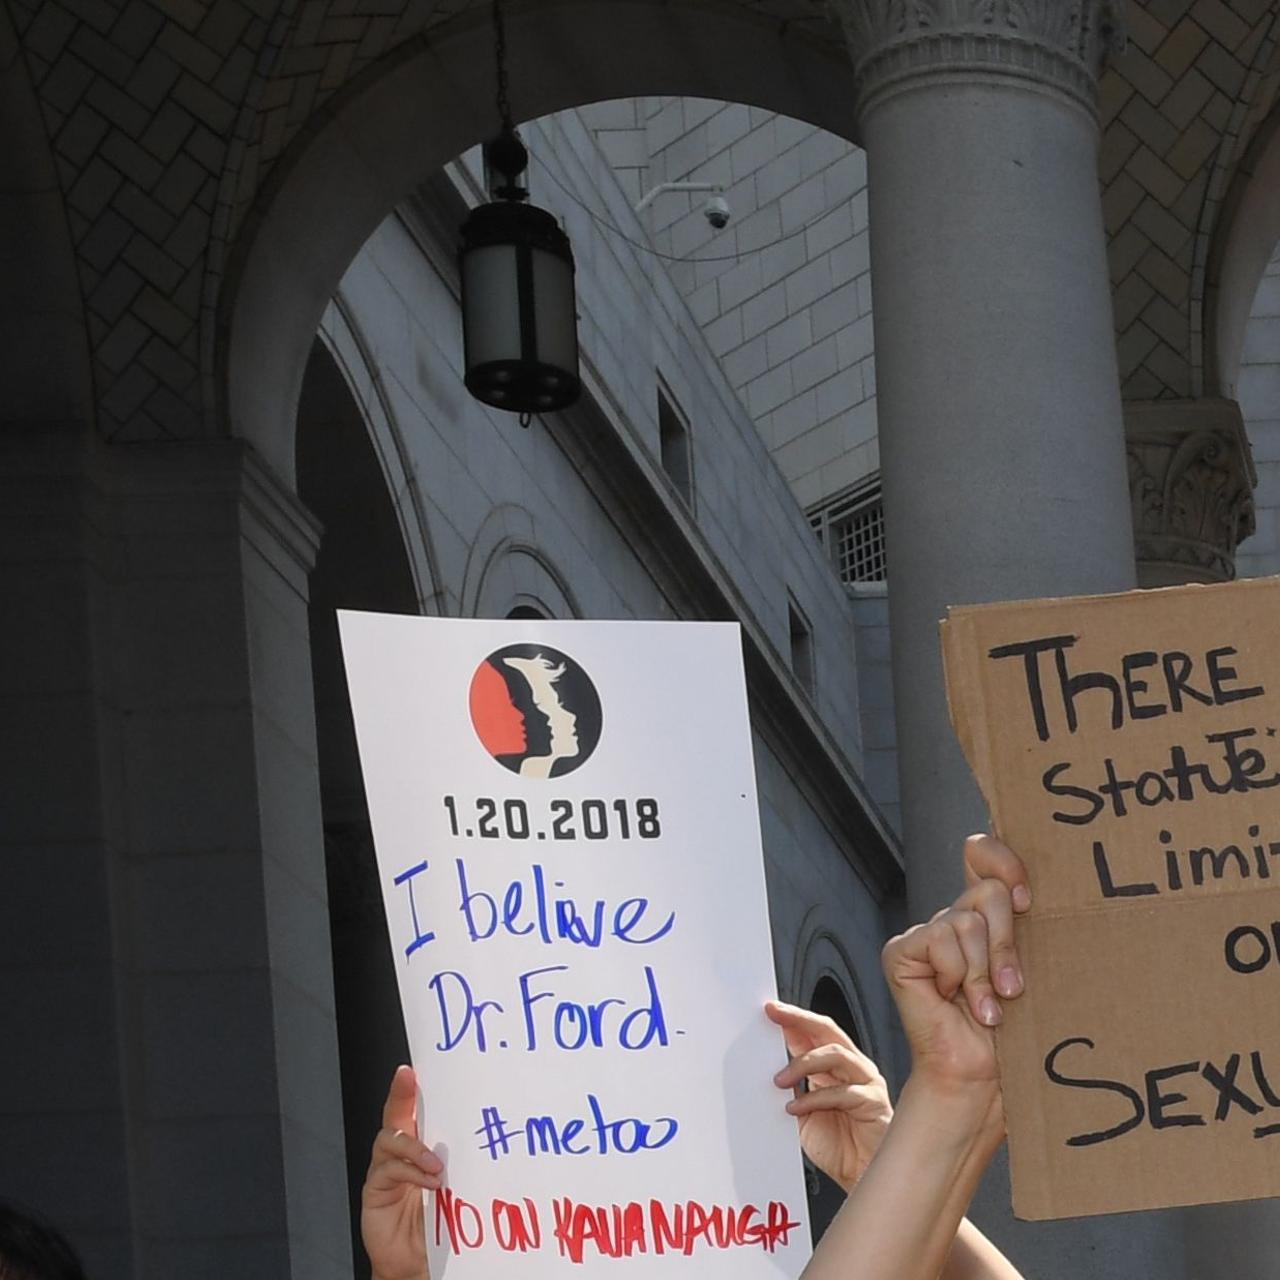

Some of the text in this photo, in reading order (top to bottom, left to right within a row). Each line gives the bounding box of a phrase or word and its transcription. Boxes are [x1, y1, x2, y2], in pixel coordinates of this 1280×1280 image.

[444, 796, 660, 839] 1.20.2018
[396, 861, 435, 955] I
[432, 975, 508, 1051] Dr.
[483, 1094, 680, 1158] #metoo
[434, 1186, 802, 1264] NO ON KAVANAUGH
